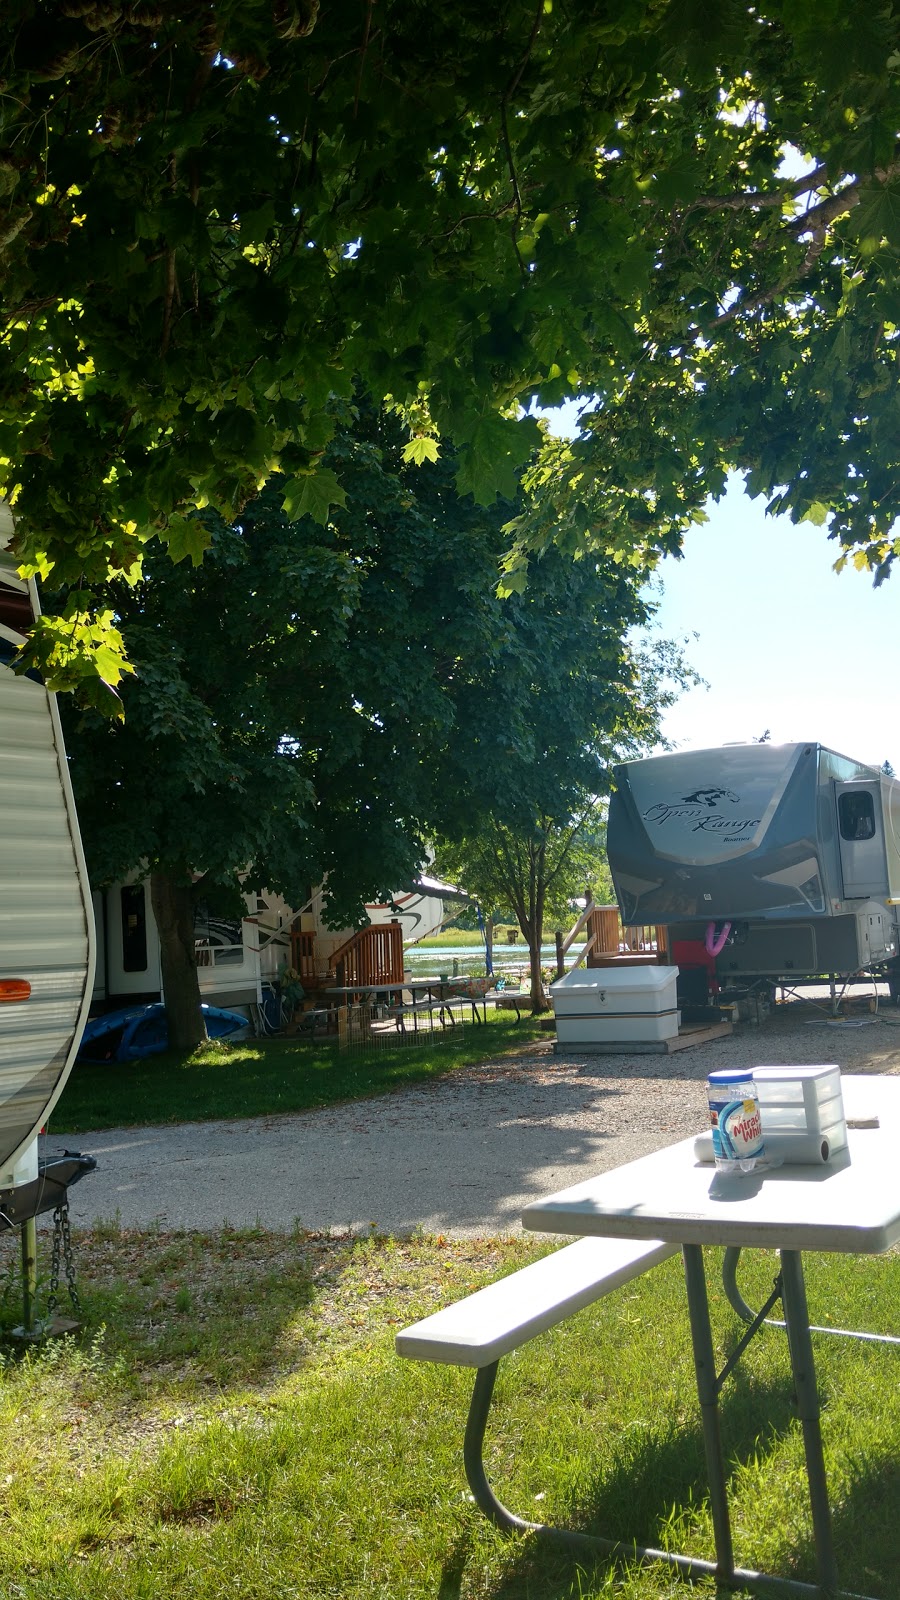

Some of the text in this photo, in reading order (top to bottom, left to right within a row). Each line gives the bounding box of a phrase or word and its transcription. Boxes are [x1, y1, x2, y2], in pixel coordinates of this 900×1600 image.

[642, 803, 703, 825] Open
[686, 815, 761, 836] Range
[733, 1109, 761, 1137] Miracl
